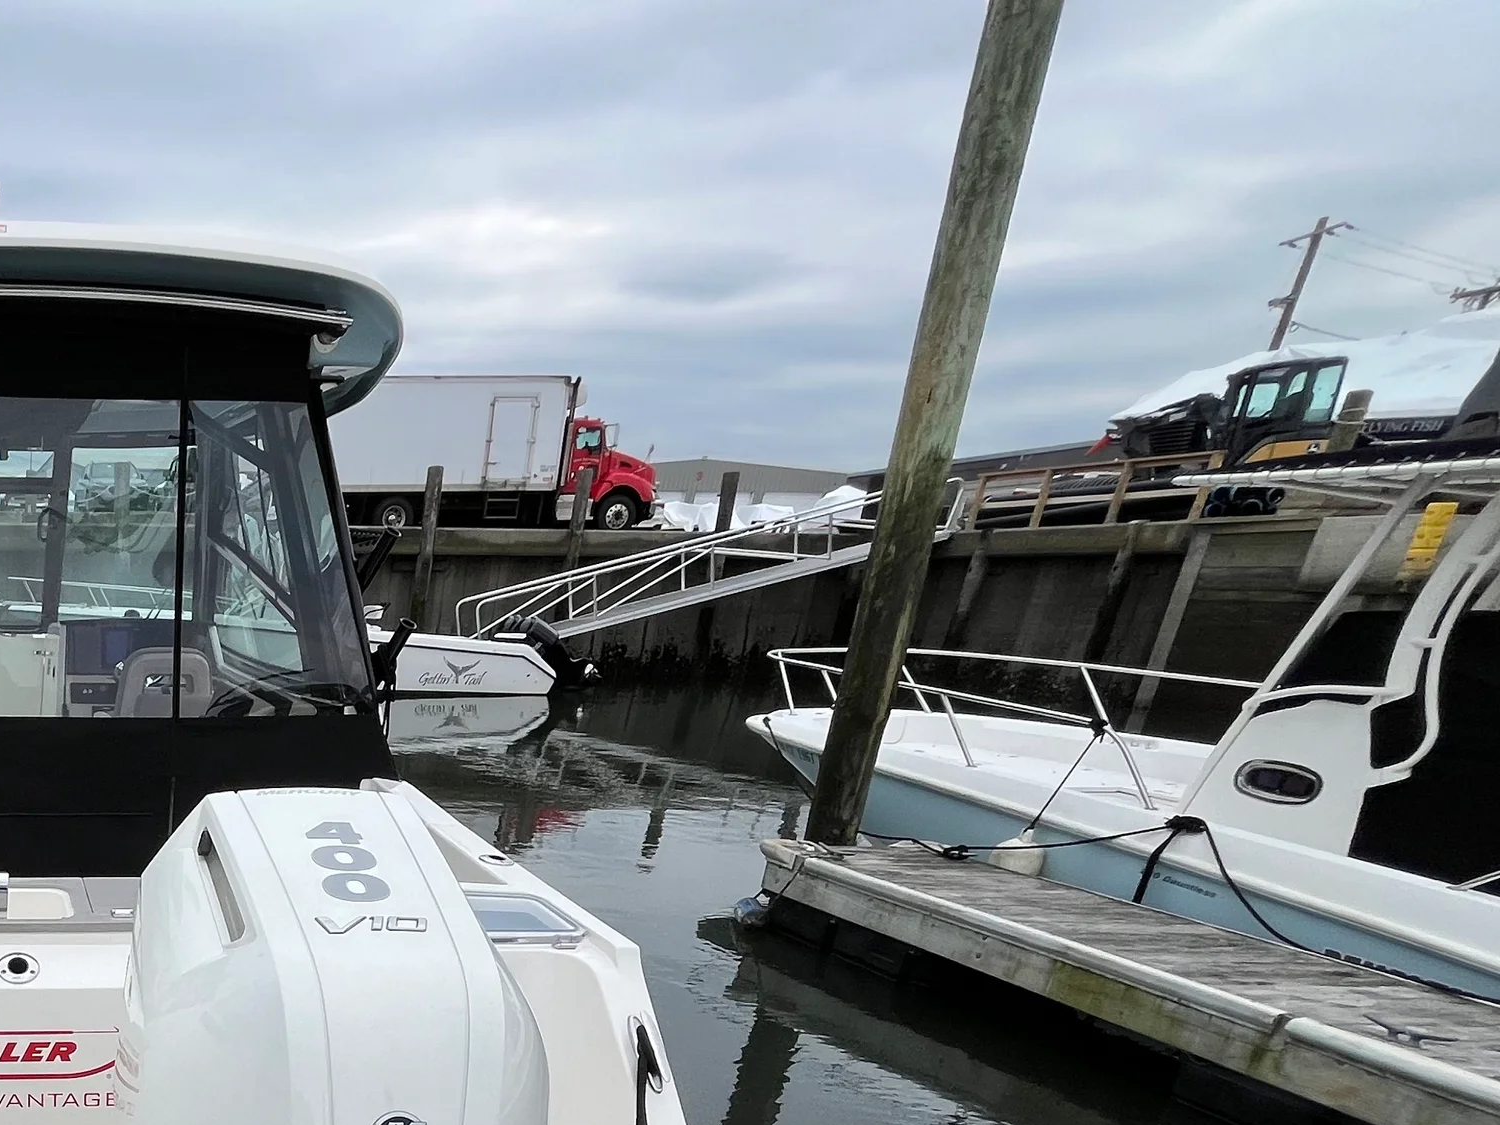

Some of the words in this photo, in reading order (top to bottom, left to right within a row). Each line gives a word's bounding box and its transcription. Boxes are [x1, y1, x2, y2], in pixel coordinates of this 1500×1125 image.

[463, 671, 488, 686] Tail
[305, 821, 391, 903] 400
[314, 915, 428, 934] V10
